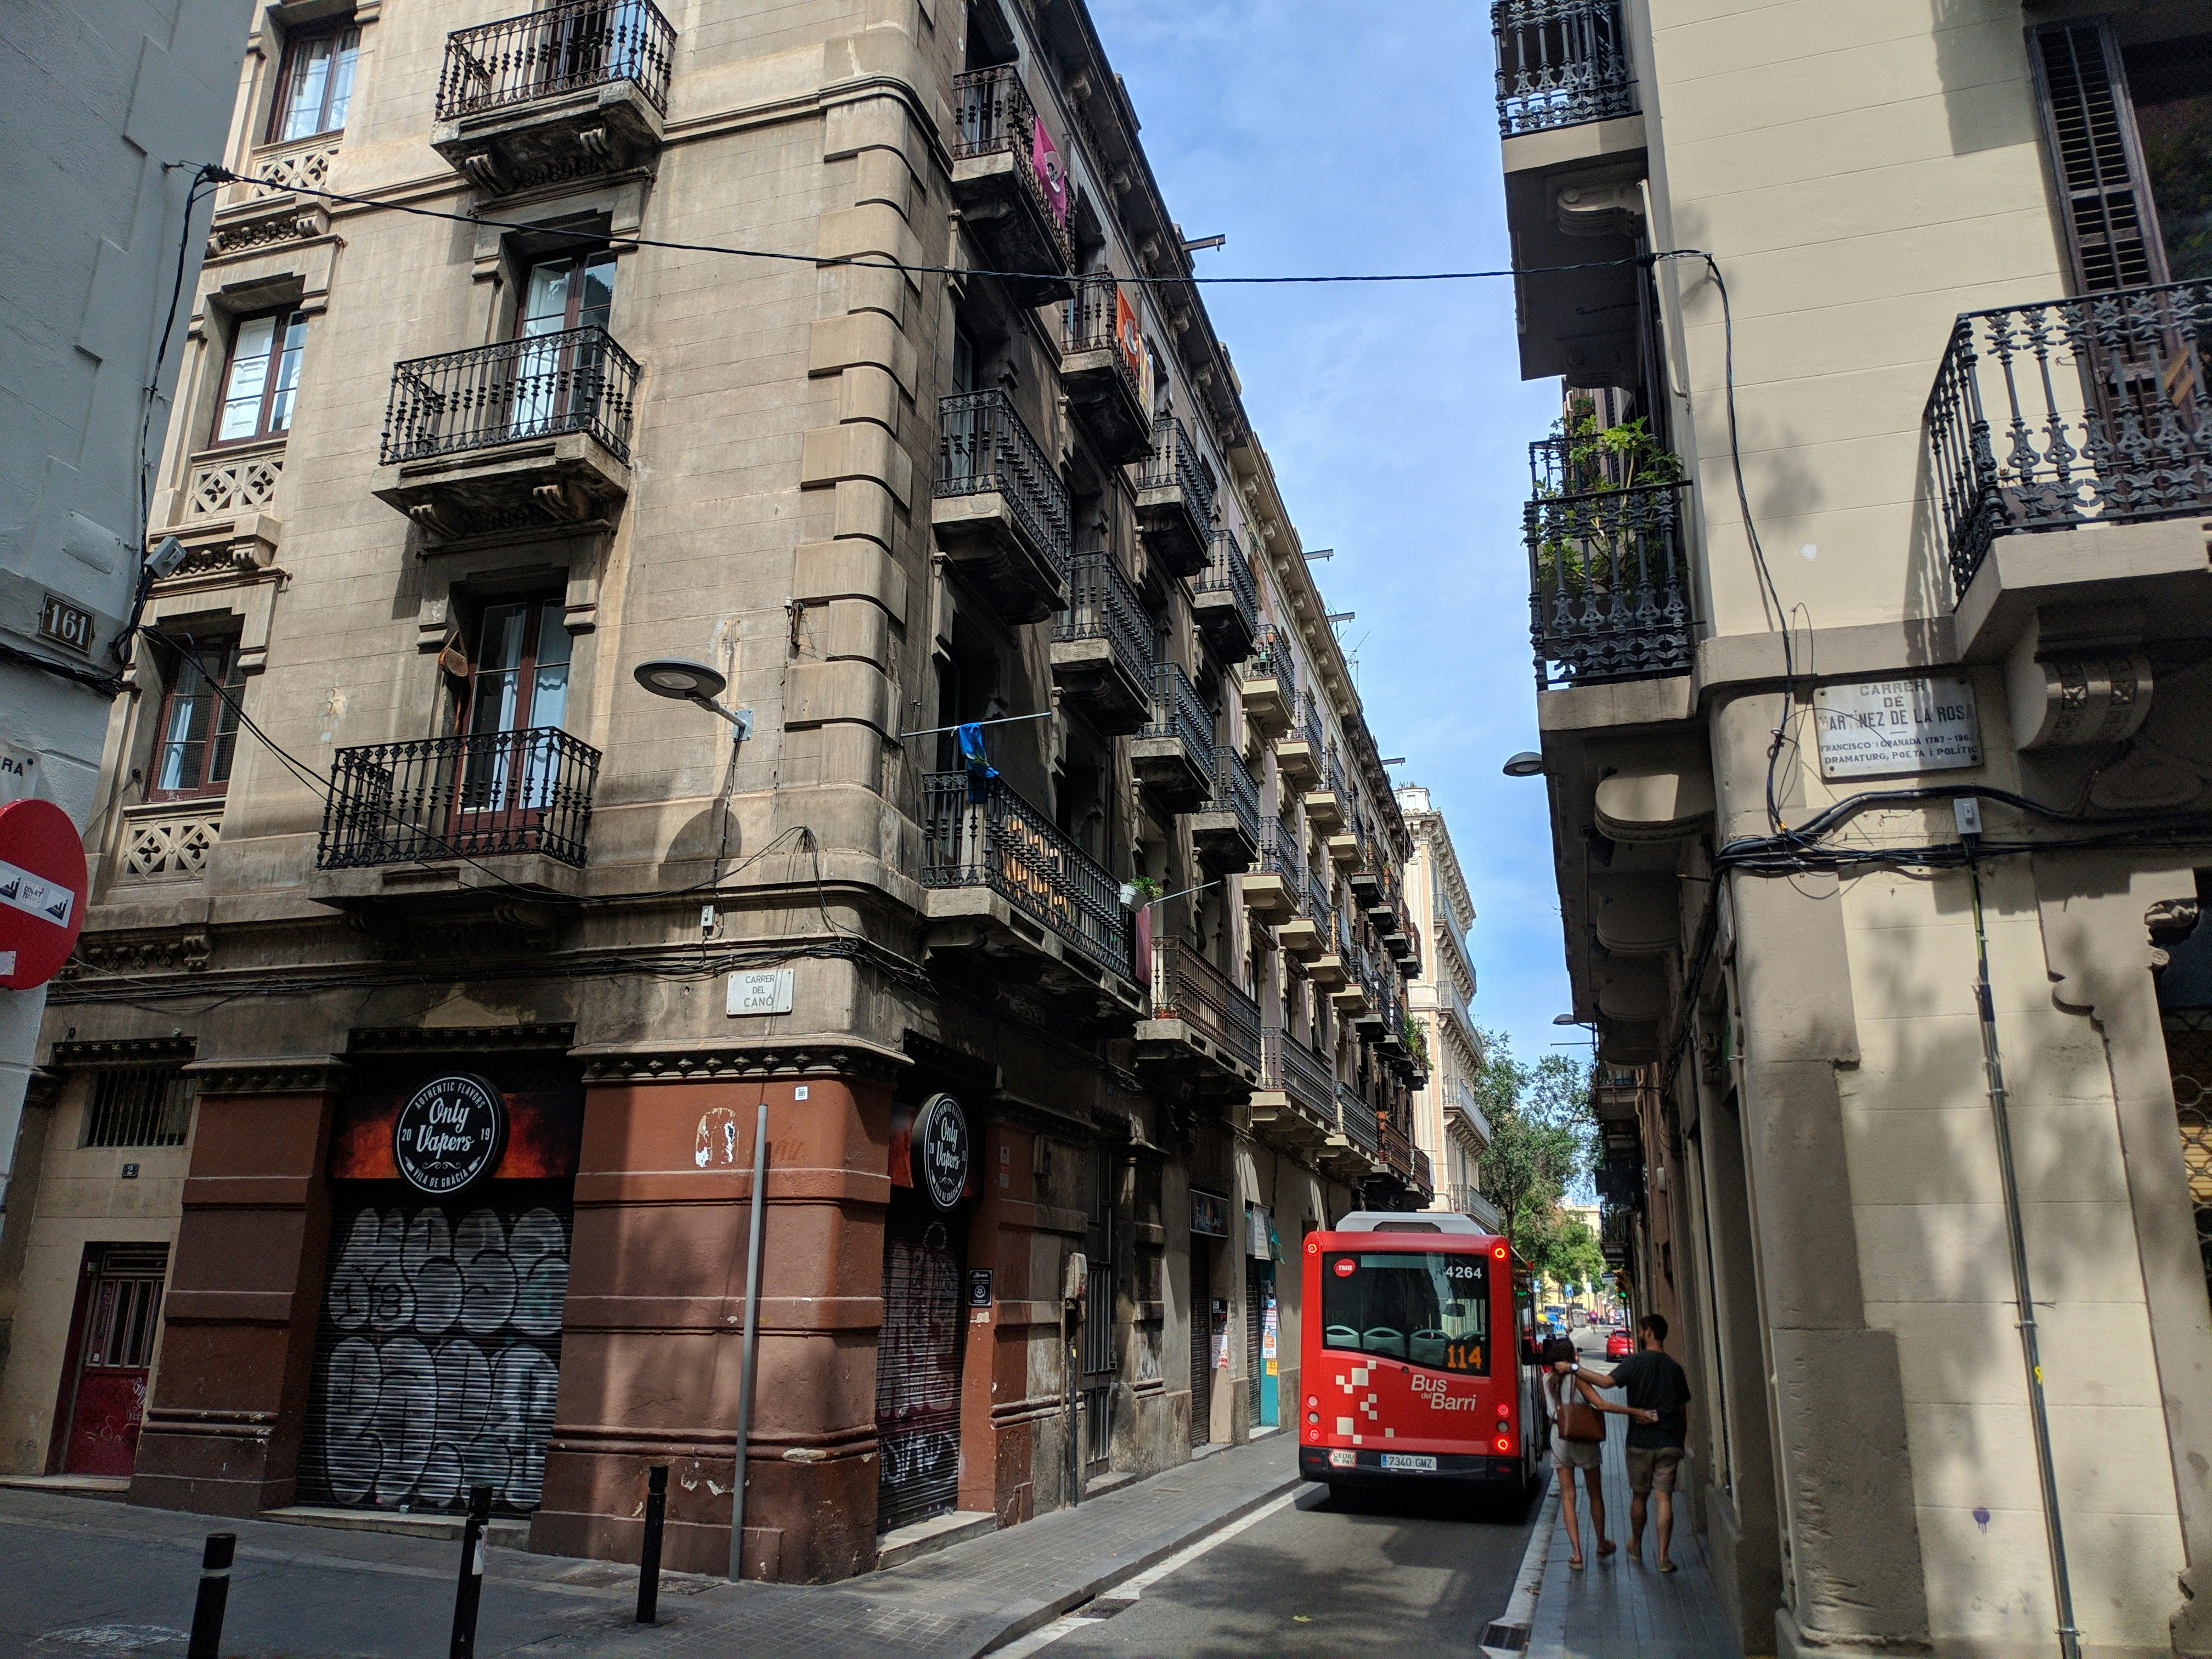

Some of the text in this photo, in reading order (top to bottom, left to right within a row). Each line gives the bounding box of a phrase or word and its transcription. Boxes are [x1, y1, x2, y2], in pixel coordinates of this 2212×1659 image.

[49, 604, 86, 645] 161
[1859, 680, 1925, 696] CARRER
[1883, 696, 1905, 708] DE
[1890, 709, 1908, 725] DE
[1914, 708, 1932, 724] LA
[1937, 704, 1974, 722] ROSA
[1820, 742, 1871, 752] FRANCISCO
[1876, 738, 1922, 747] (GRANADA
[1825, 753, 1889, 764] DRAMATURG,
[1892, 750, 1926, 759] POETA
[1937, 744, 1978, 756] POLÍTIC
[0, 755, 23, 777] RA
[744, 974, 775, 984] CARRER
[752, 986, 766, 995] DEL
[743, 994, 774, 1007] CANÓ
[414, 1081, 486, 1110] AUTHENTIC FLAVORS
[429, 1097, 470, 1133] Only
[402, 1125, 490, 1160] 20 Vapers 19
[941, 1116, 958, 1153] Only
[929, 1142, 935, 1154] 20
[935, 1140, 961, 1175] Vapers
[127, 1165, 133, 1175] 2
[413, 1168, 469, 1188] VILA DE GRÀCIA
[1445, 1266, 1482, 1279] 4264
[1567, 1285, 1571, 1296] P
[1447, 1345, 1482, 1369] 114
[1410, 1374, 1447, 1392] Bus
[1430, 1392, 1477, 1411] Barri
[1389, 1457, 1432, 1468] 7340 GMZ
